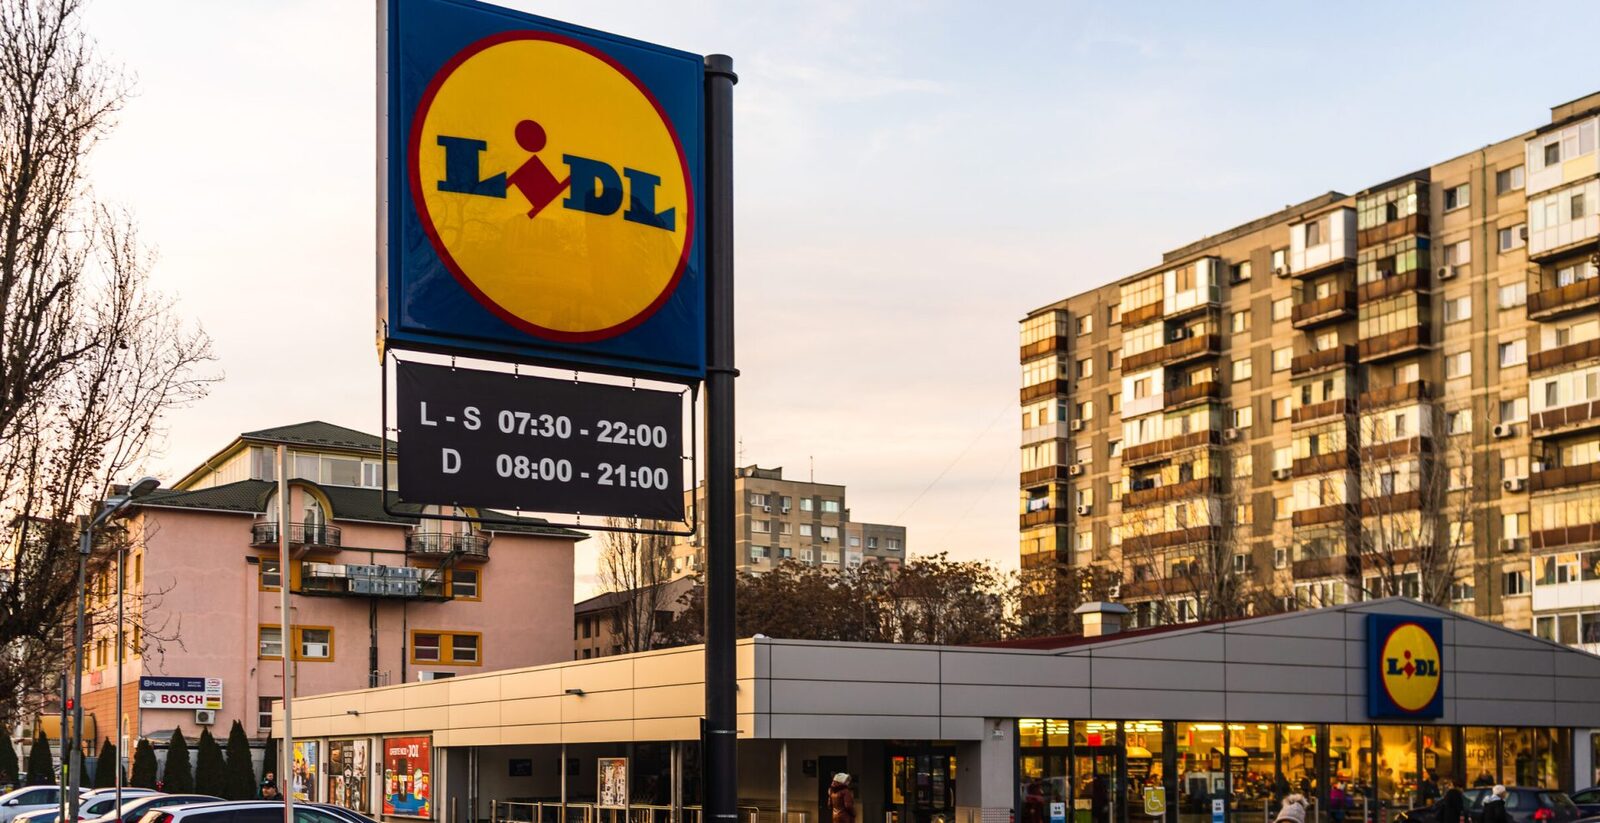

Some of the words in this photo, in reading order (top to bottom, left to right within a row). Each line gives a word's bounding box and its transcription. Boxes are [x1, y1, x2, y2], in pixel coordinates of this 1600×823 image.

[420, 401, 437, 426] L
[463, 406, 481, 430] S
[498, 410, 572, 439] 07:30
[597, 420, 667, 448] 22:00
[442, 448, 461, 474] D
[496, 454, 572, 482] 08:00
[597, 463, 669, 490] 21:00
[161, 694, 203, 704] BOSCH
